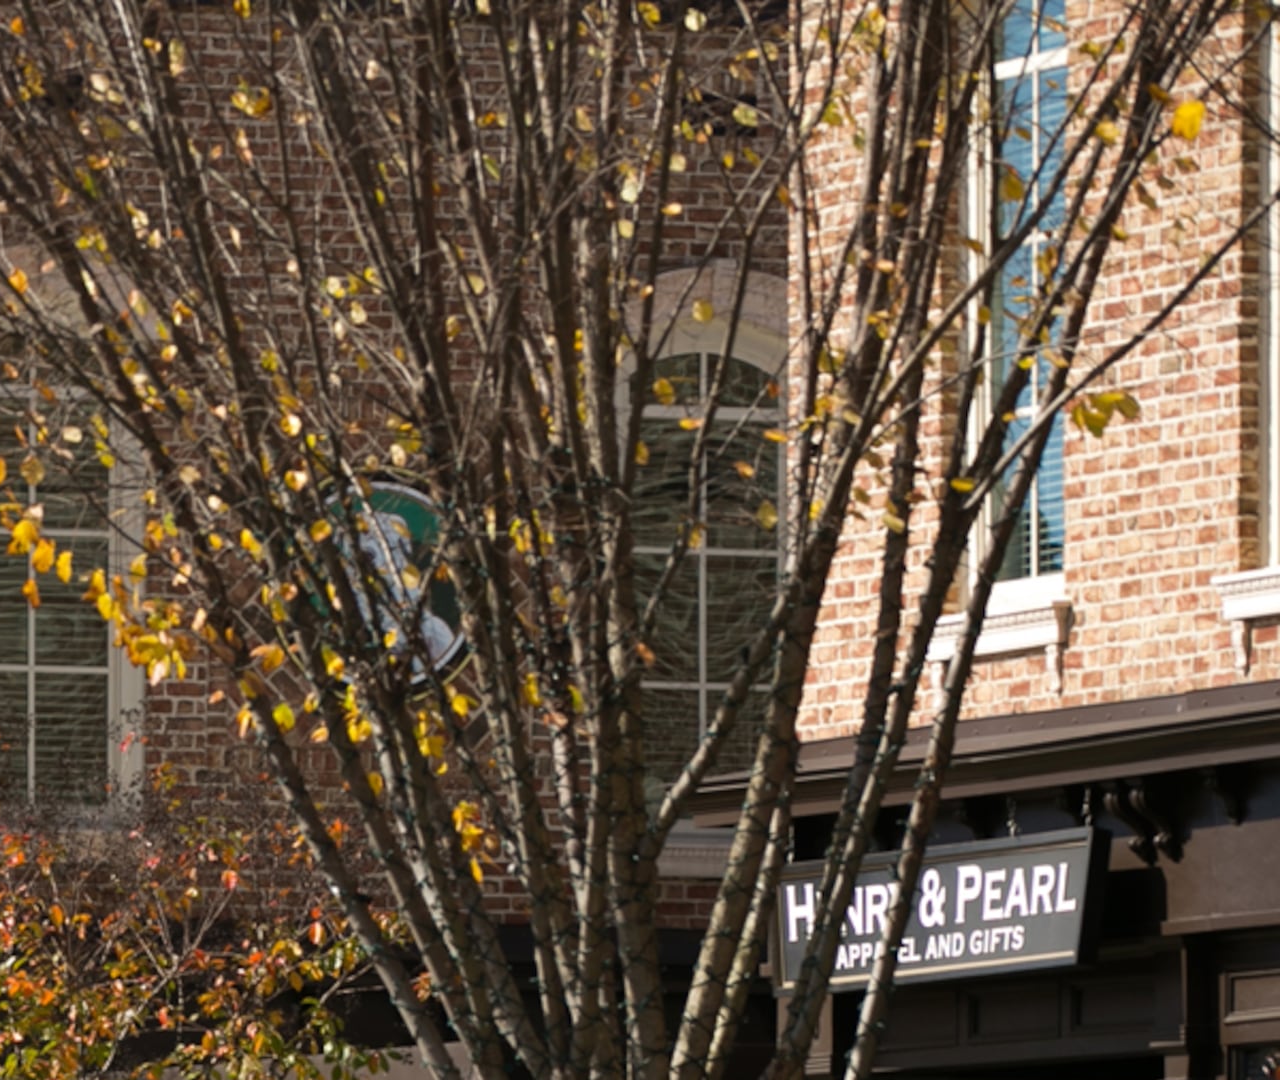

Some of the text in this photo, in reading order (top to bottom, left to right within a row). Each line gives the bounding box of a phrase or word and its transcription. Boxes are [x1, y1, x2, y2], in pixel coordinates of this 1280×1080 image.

[918, 868, 947, 928] &
[955, 862, 1076, 924] PEARL
[926, 933, 965, 959] AND
[970, 926, 1024, 952] GIFTS
